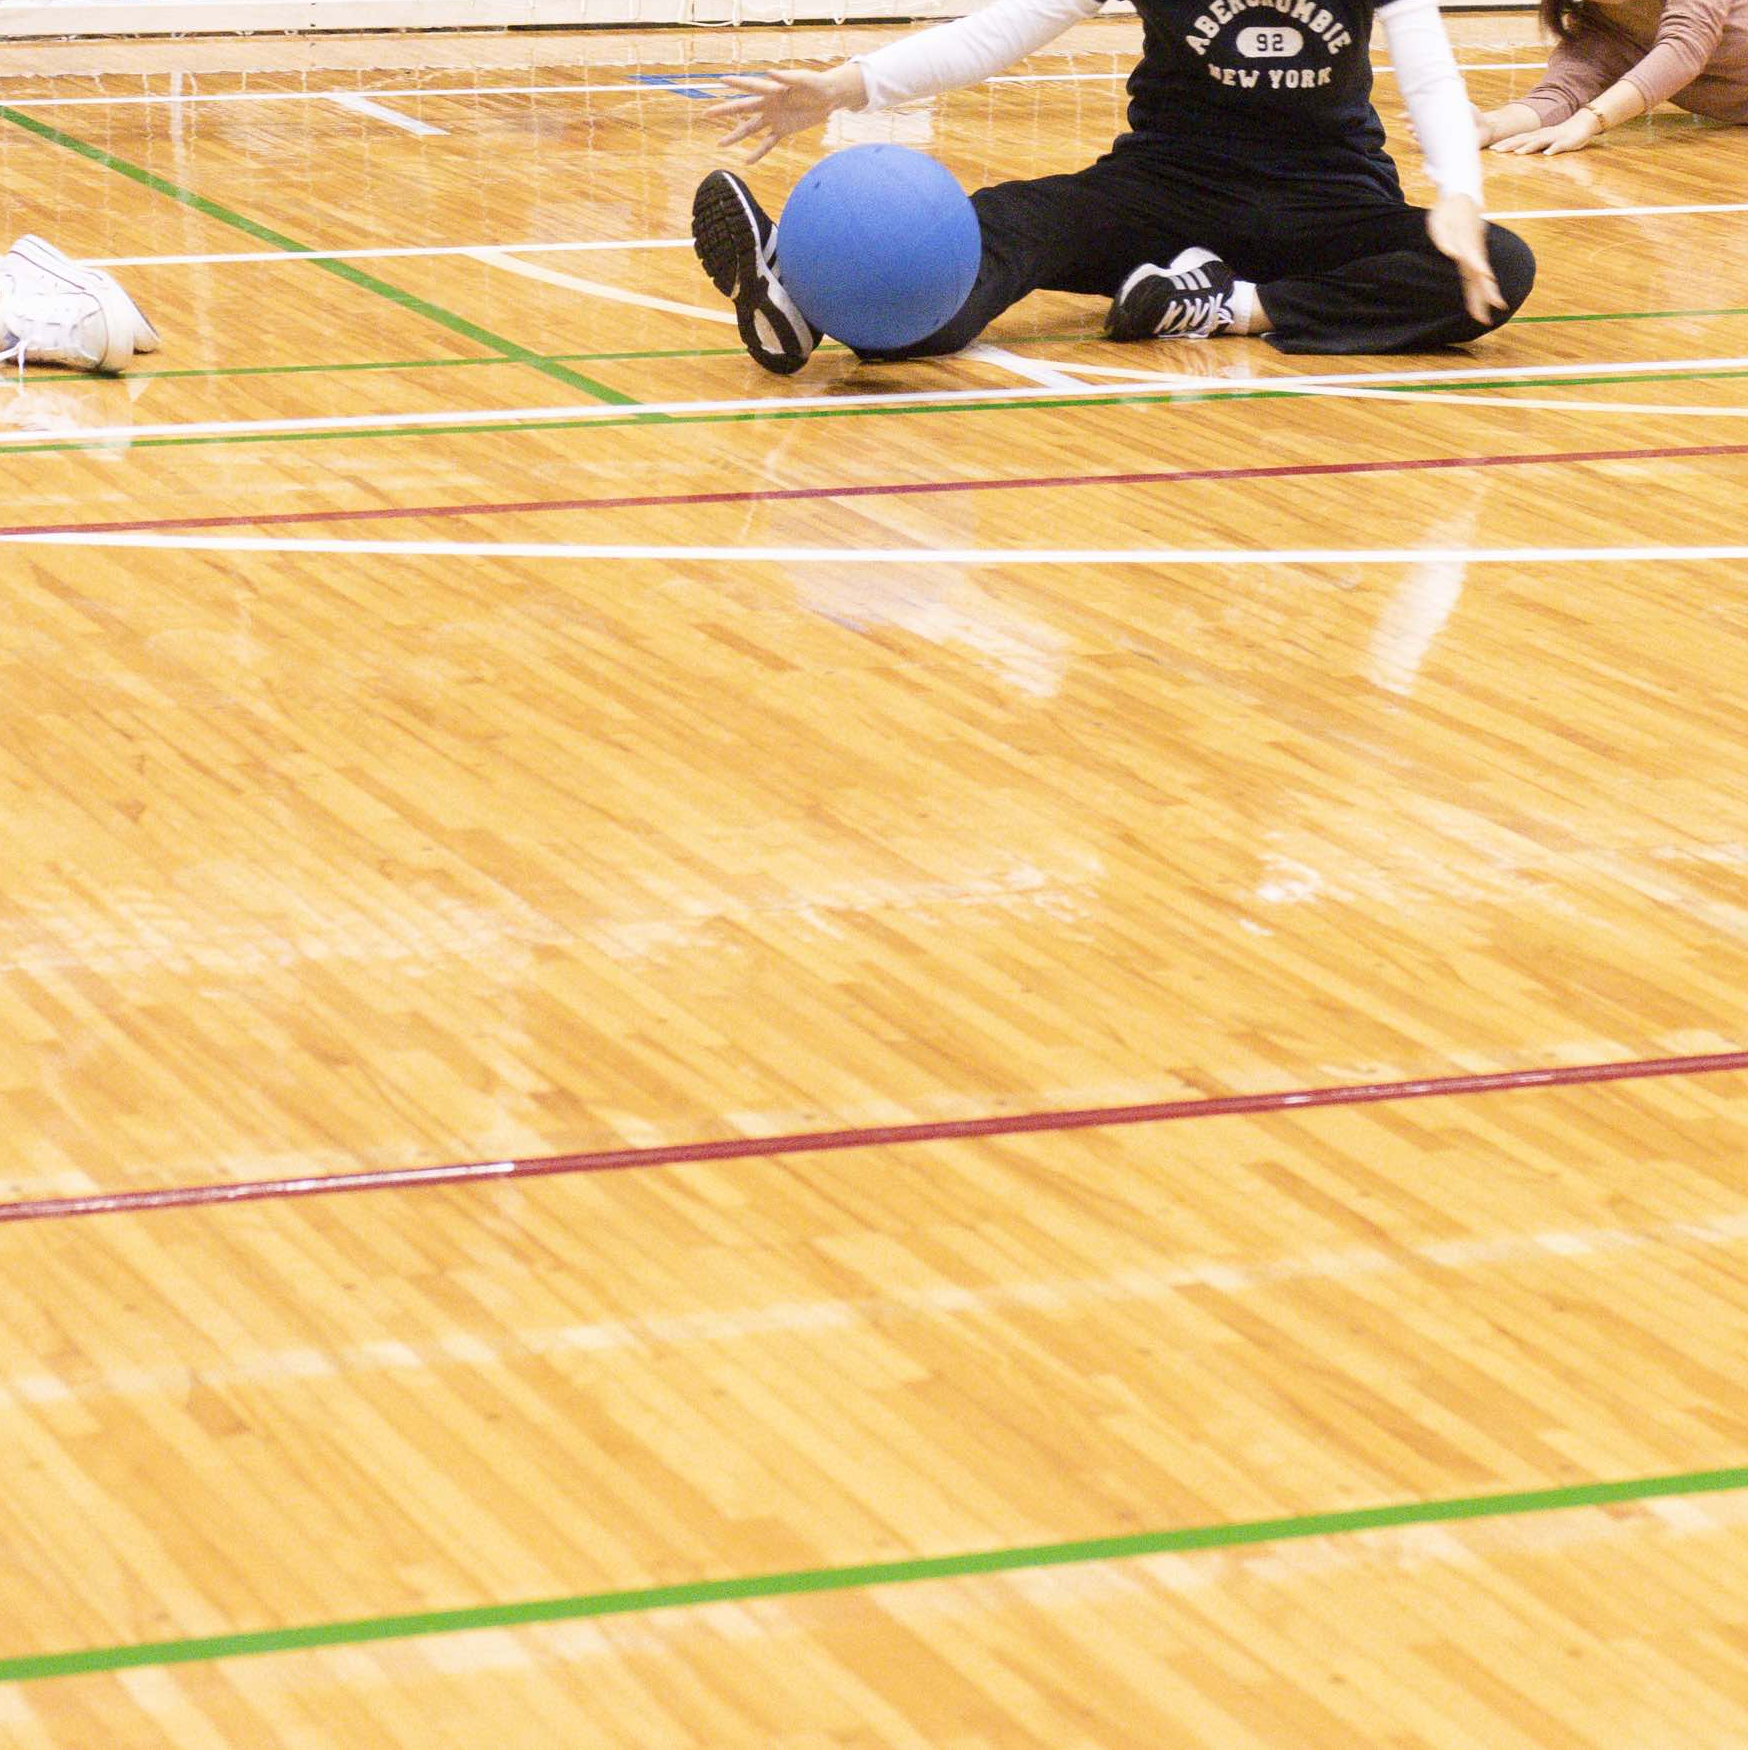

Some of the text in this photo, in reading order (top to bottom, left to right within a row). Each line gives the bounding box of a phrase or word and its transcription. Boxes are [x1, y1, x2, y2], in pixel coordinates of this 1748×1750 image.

[1256, 33, 1285, 51] 92
[1208, 63, 1332, 89] NEW YORK
